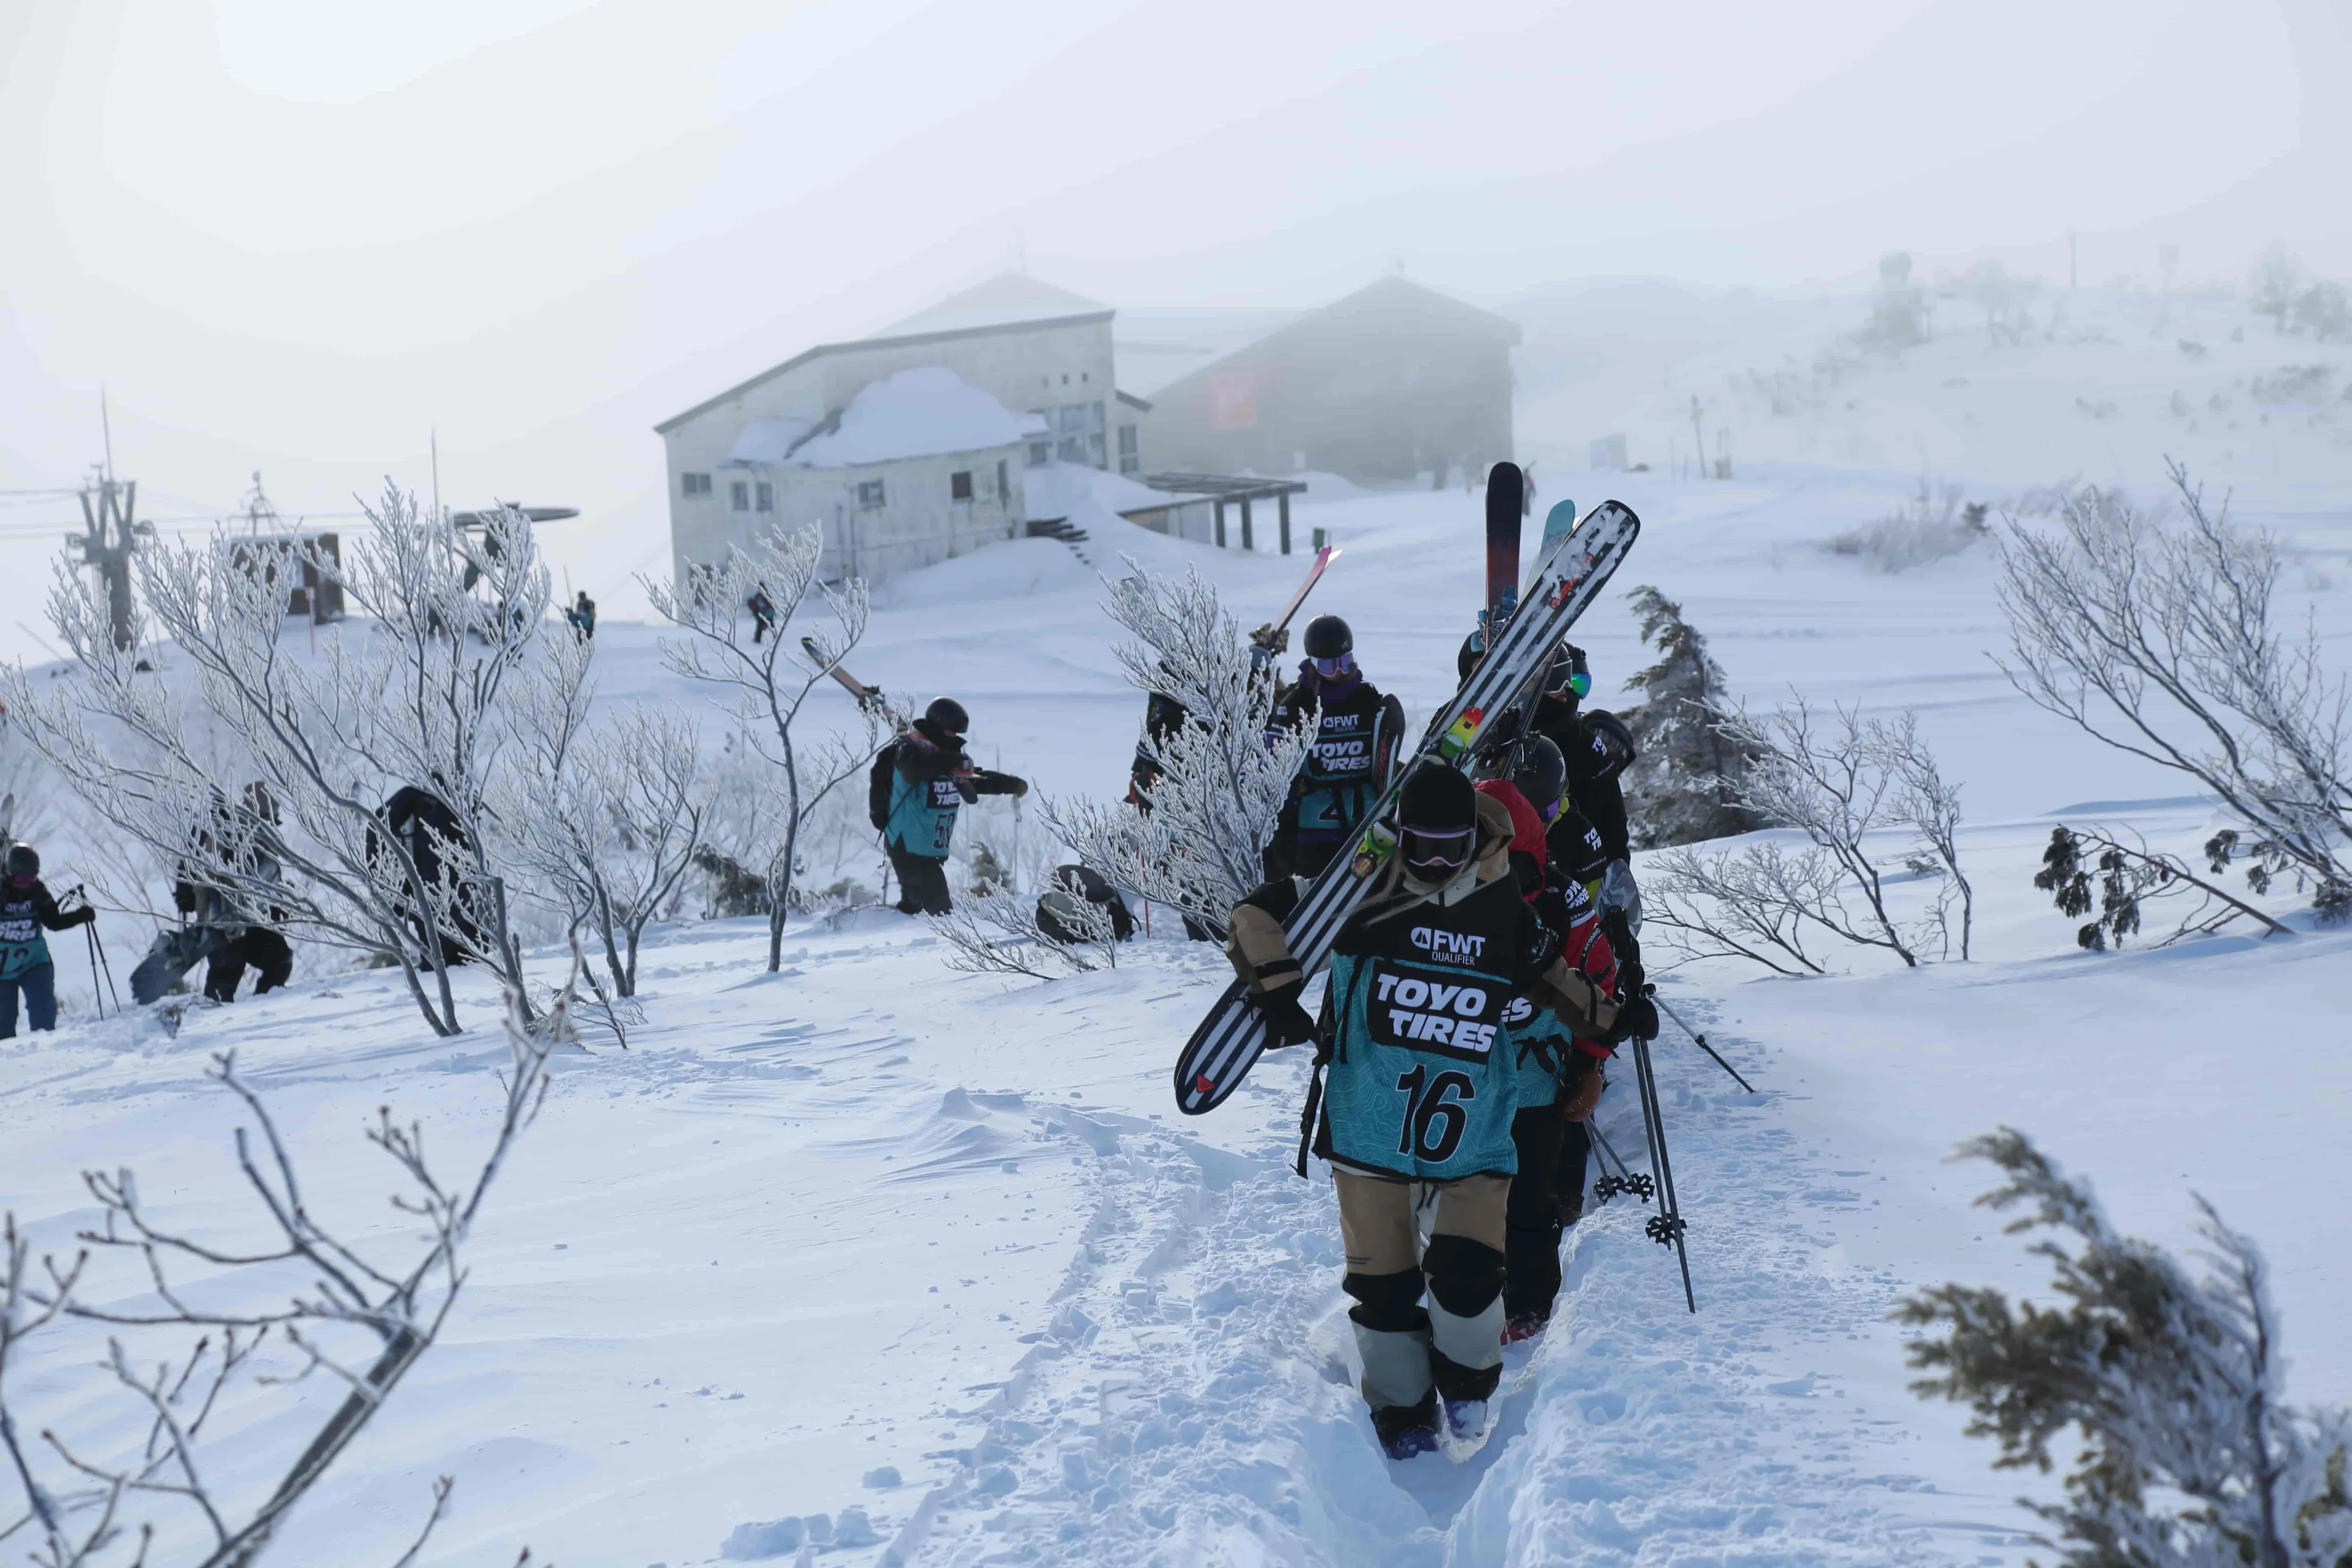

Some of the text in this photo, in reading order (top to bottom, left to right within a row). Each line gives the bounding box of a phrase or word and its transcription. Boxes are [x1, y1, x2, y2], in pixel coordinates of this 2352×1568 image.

[1334, 715, 1359, 727] FWT
[1311, 740, 1364, 758] TOYO
[1320, 755, 1370, 772] TIRES
[1565, 879, 1581, 904] OYO
[0, 919, 32, 930] OYO
[1433, 929, 1486, 957] FWT
[1432, 951, 1475, 966] QUALIFIER
[1377, 973, 1486, 1017] TOYO
[1389, 1009, 1497, 1052] TIRES
[1396, 1063, 1476, 1164] 16
